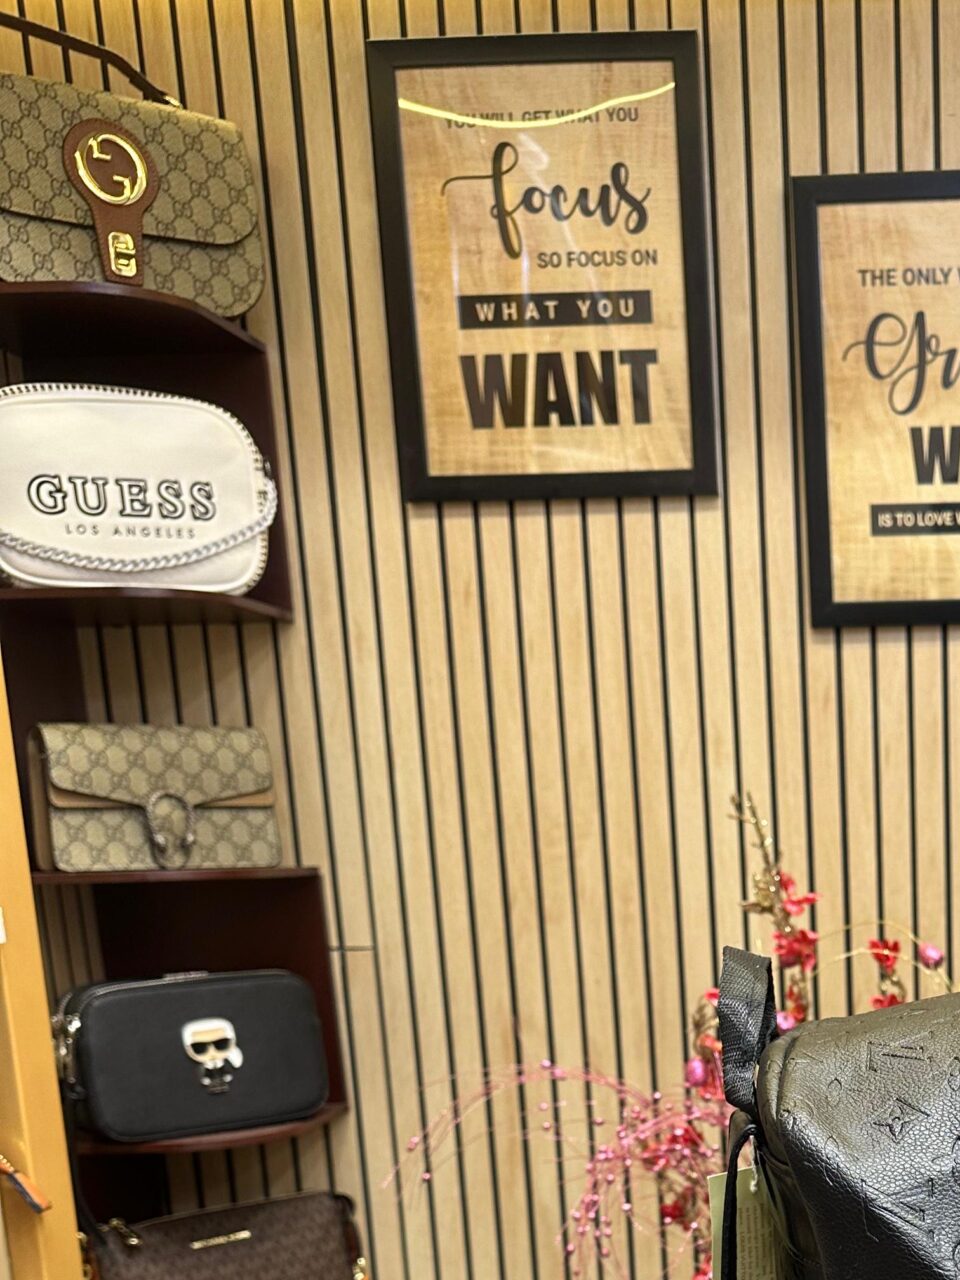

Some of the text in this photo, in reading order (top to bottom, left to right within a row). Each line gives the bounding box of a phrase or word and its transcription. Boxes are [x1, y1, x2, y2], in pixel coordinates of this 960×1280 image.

[605, 106, 640, 122] YOU
[441, 142, 652, 259] focus
[537, 249, 659, 269] SO FOCUS ON
[857, 268, 898, 287] THE
[902, 267, 953, 286] ONLY
[475, 298, 635, 322] WHAT YOU
[458, 348, 659, 430] WANT
[27, 474, 217, 522] GUESS
[878, 512, 893, 528] IS
[895, 511, 916, 527] TO
[917, 510, 954, 527] LOVE
[64, 524, 197, 540] LOS ANGELES
